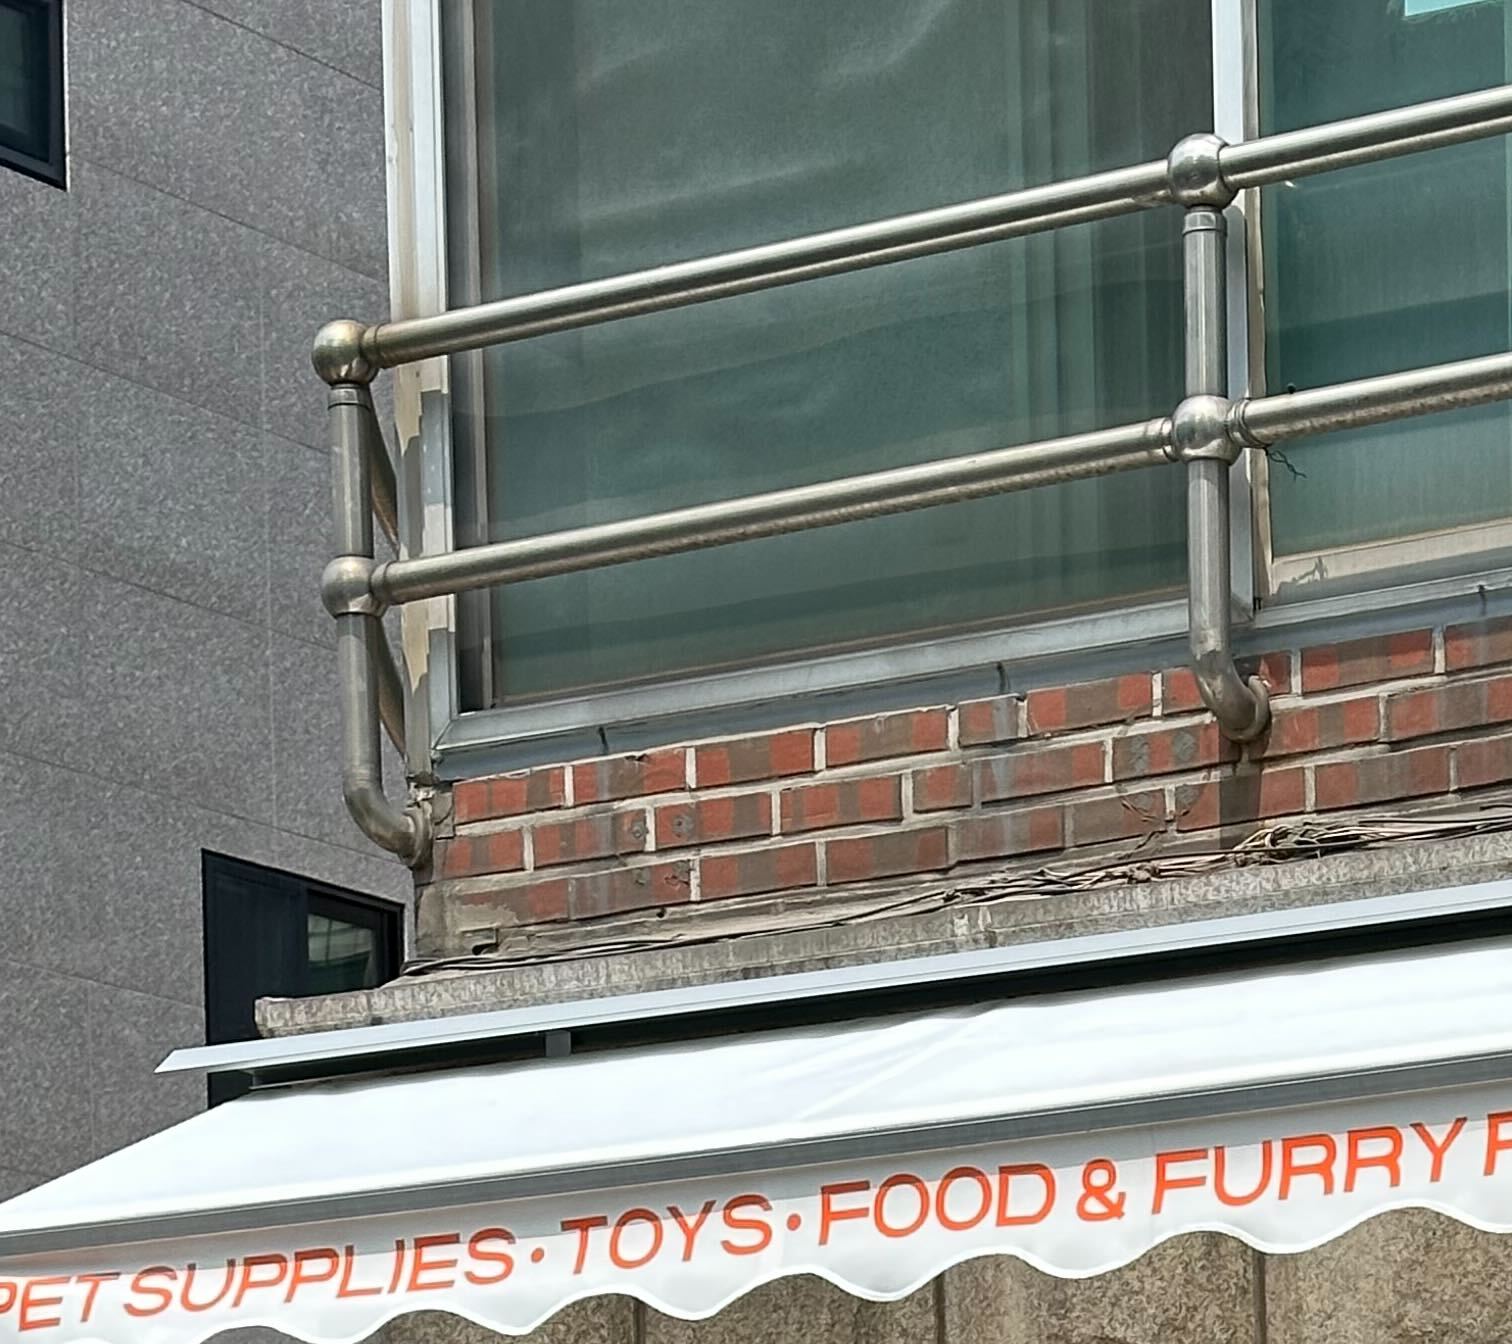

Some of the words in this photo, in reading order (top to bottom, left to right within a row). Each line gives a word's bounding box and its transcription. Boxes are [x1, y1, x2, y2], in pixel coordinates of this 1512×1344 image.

[123, 1227, 516, 1317] SUPPLIES
[561, 1194, 772, 1275] TOYS
[817, 1163, 1057, 1245] FOOD
[1075, 1158, 1126, 1221] &
[1152, 1117, 1467, 1214] FURRY
